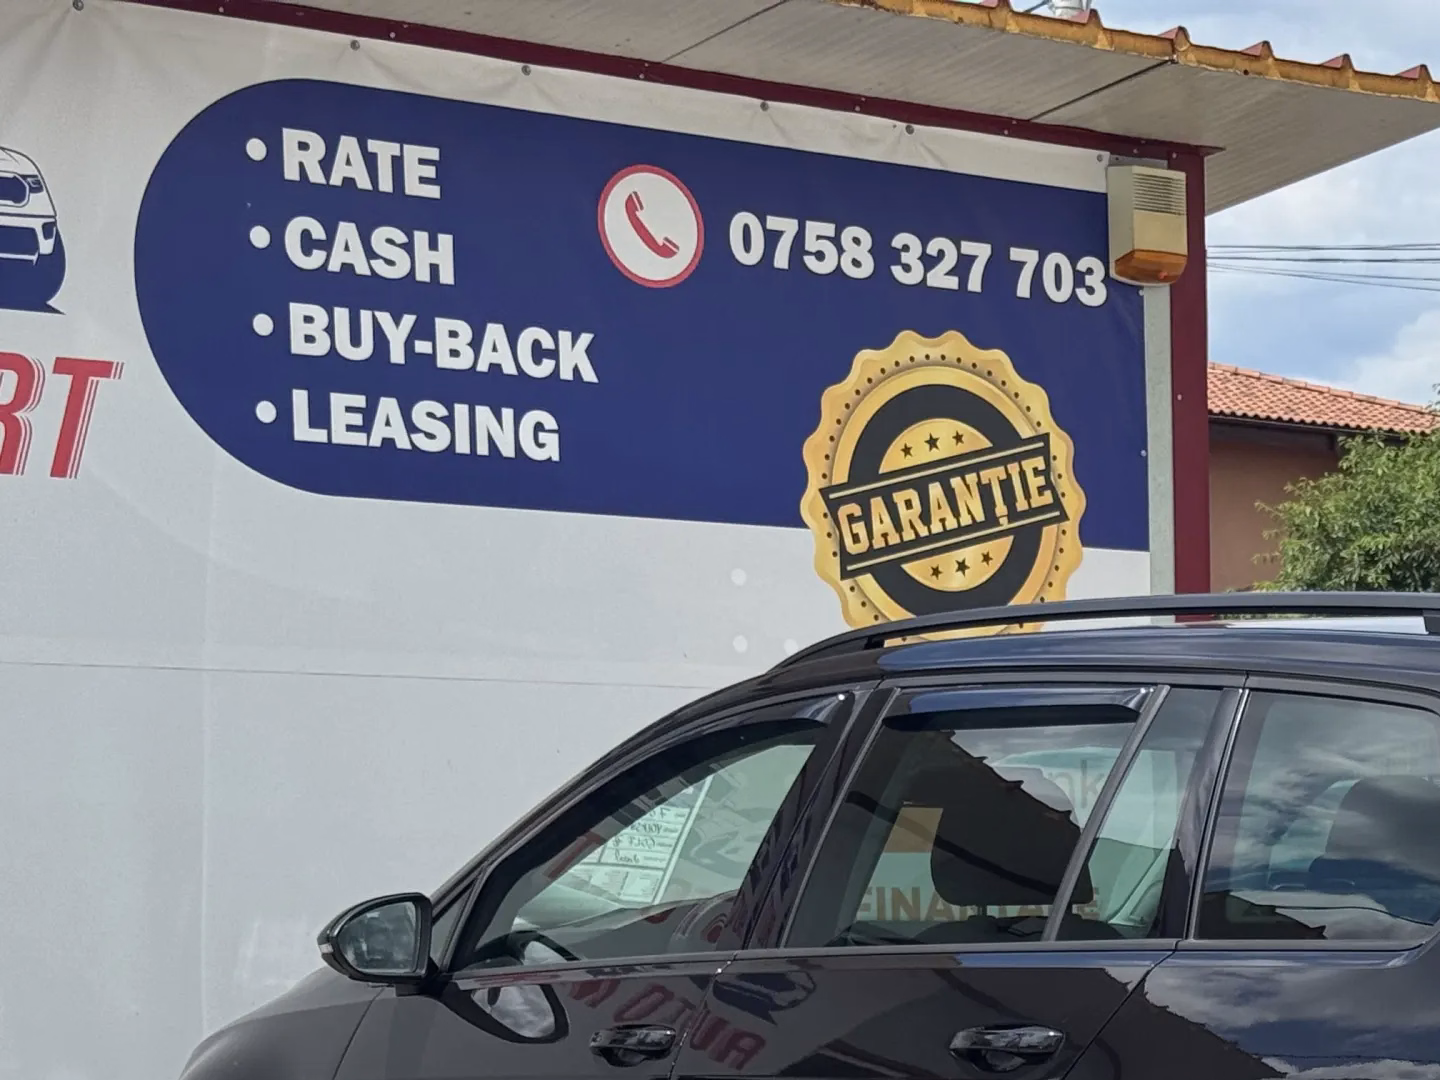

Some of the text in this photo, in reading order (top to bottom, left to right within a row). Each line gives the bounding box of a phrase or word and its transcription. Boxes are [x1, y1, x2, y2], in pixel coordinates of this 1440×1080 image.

[281, 127, 441, 199] RATE
[284, 216, 455, 285] CASH
[729, 211, 1108, 307] 0758 327 703
[289, 302, 599, 383] BUY-BACK
[292, 389, 560, 461] LEASING
[837, 456, 1054, 555] GARANȚIE
